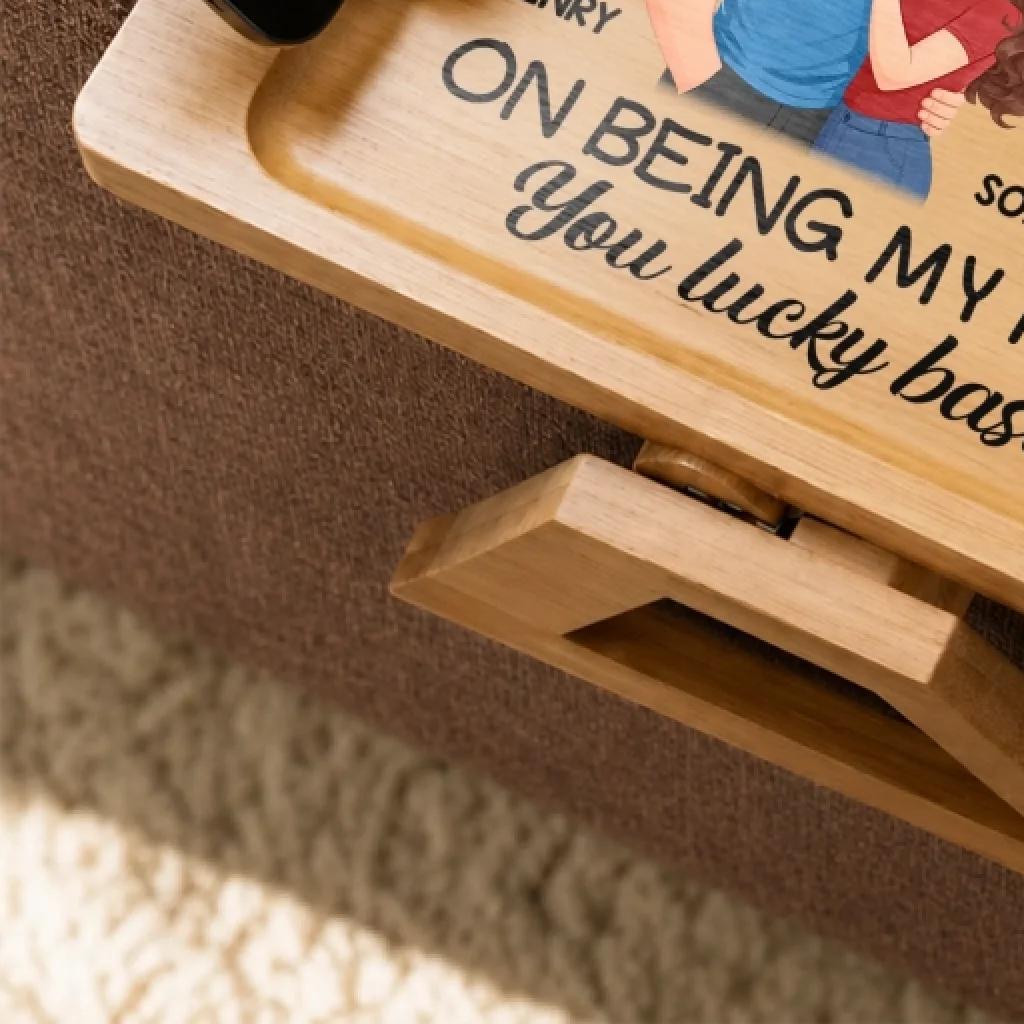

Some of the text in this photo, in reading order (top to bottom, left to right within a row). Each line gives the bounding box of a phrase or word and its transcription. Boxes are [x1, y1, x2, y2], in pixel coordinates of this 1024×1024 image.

[441, 37, 585, 138] ON
[582, 96, 853, 261] BEING
[864, 225, 1004, 322] MY
[505, 159, 672, 280] You
[677, 238, 889, 390] lucky
